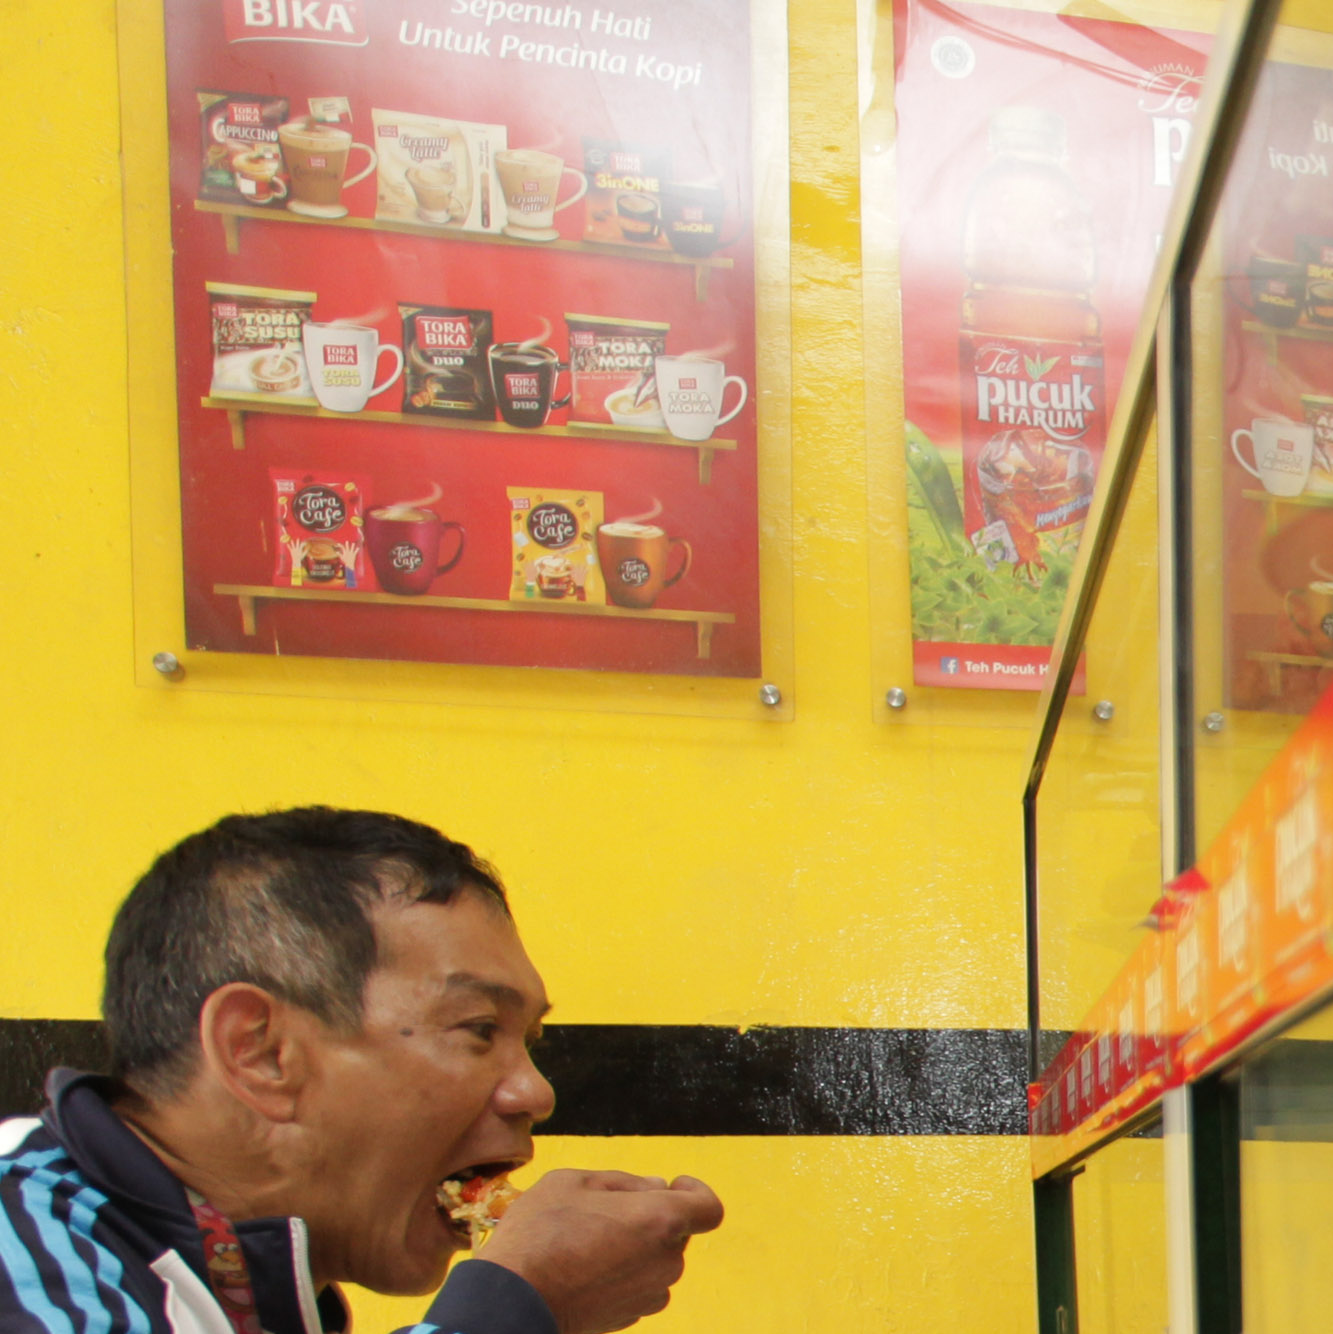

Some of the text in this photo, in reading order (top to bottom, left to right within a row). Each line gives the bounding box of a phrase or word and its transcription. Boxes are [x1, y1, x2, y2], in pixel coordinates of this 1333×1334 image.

[243, 0, 355, 33] BIKA
[451, 0, 652, 40] Sepenuh Hati
[399, 20, 703, 91] Untuk Pencinta Kopi
[212, 118, 278, 142] CAPPUCCINO
[399, 135, 449, 151] Creamy
[595, 173, 660, 193] 3inONE
[242, 312, 300, 327] TORA
[420, 320, 466, 335] TORA
[244, 326, 300, 340] SUSU
[425, 333, 467, 346] BIKA
[326, 346, 354, 356] TORA
[598, 342, 651, 355] TORA
[327, 354, 355, 364] BIKA
[974, 347, 1020, 375] Teh
[508, 377, 537, 387] TORA
[511, 386, 537, 395] BIKA
[669, 392, 709, 401] TORA
[977, 374, 1095, 422] pucuk
[669, 402, 714, 414] MOKA
[998, 404, 1090, 435] HARUM
[299, 492, 340, 510] Tora
[300, 508, 345, 528] Cafe
[532, 507, 571, 525] Tora
[534, 523, 576, 543] Cafe
[392, 545, 420, 557] Tora
[392, 554, 423, 570] Cafe
[965, 661, 989, 673] Teh
[993, 662, 1035, 675] Pucuk
